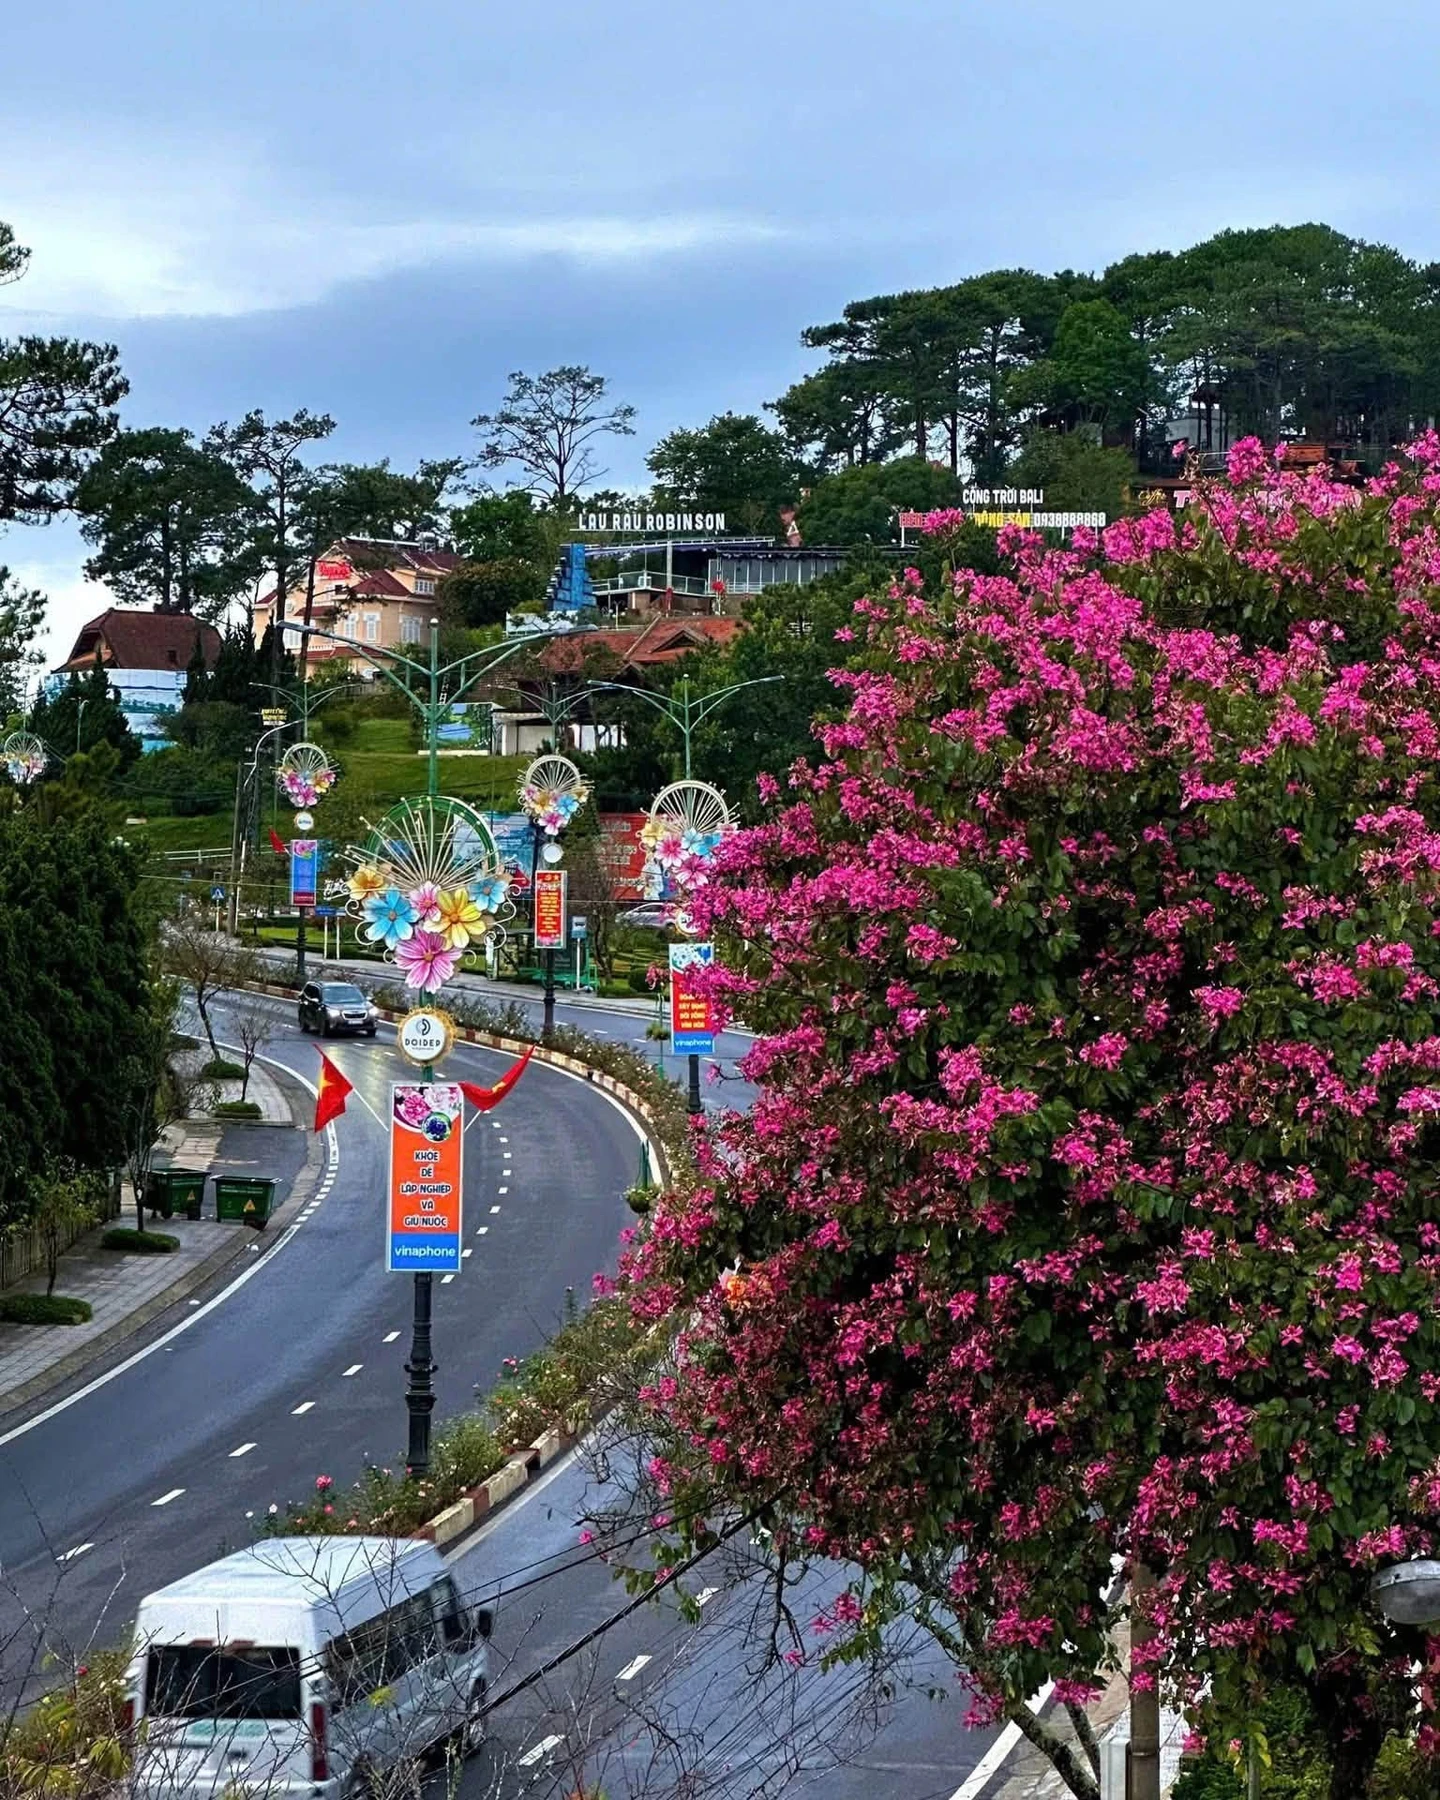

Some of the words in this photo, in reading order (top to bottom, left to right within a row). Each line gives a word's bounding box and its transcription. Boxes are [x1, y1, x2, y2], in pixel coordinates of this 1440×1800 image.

[992, 485, 1017, 504] TRỜI
[1019, 488, 1044, 504] BALI
[612, 513, 641, 530] RAU
[646, 513, 726, 530] ROBINSON
[394, 1245, 456, 1258] vinaphone
